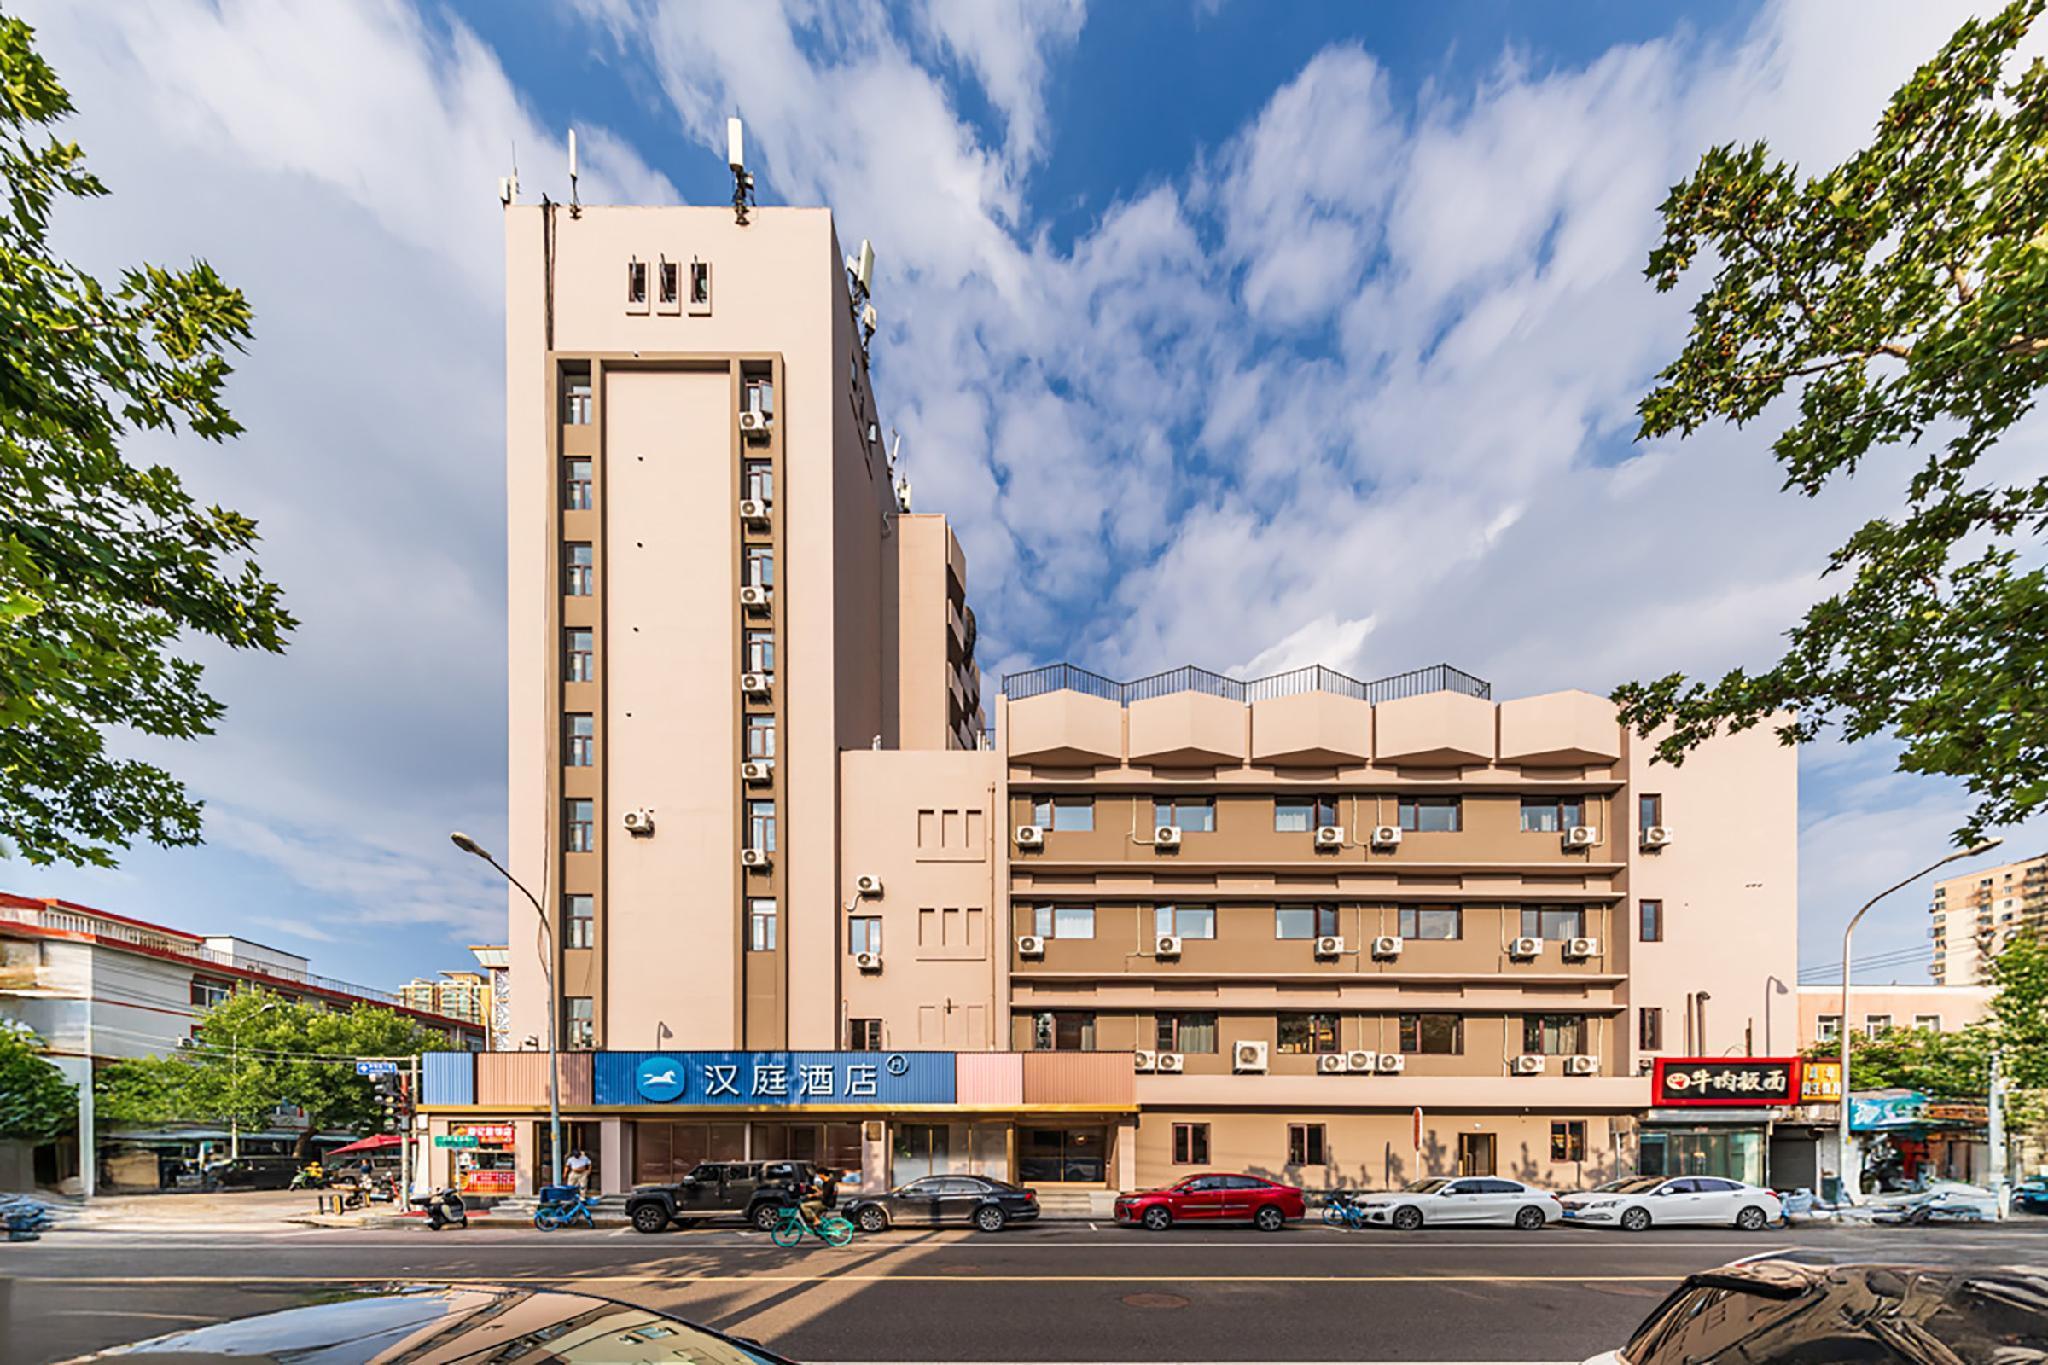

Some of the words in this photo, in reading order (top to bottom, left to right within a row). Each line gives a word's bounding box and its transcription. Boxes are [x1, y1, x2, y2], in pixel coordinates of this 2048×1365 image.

[704, 1063, 877, 1096] 汉庭酒店
[1690, 1068, 1786, 1094] 牛肉板面
